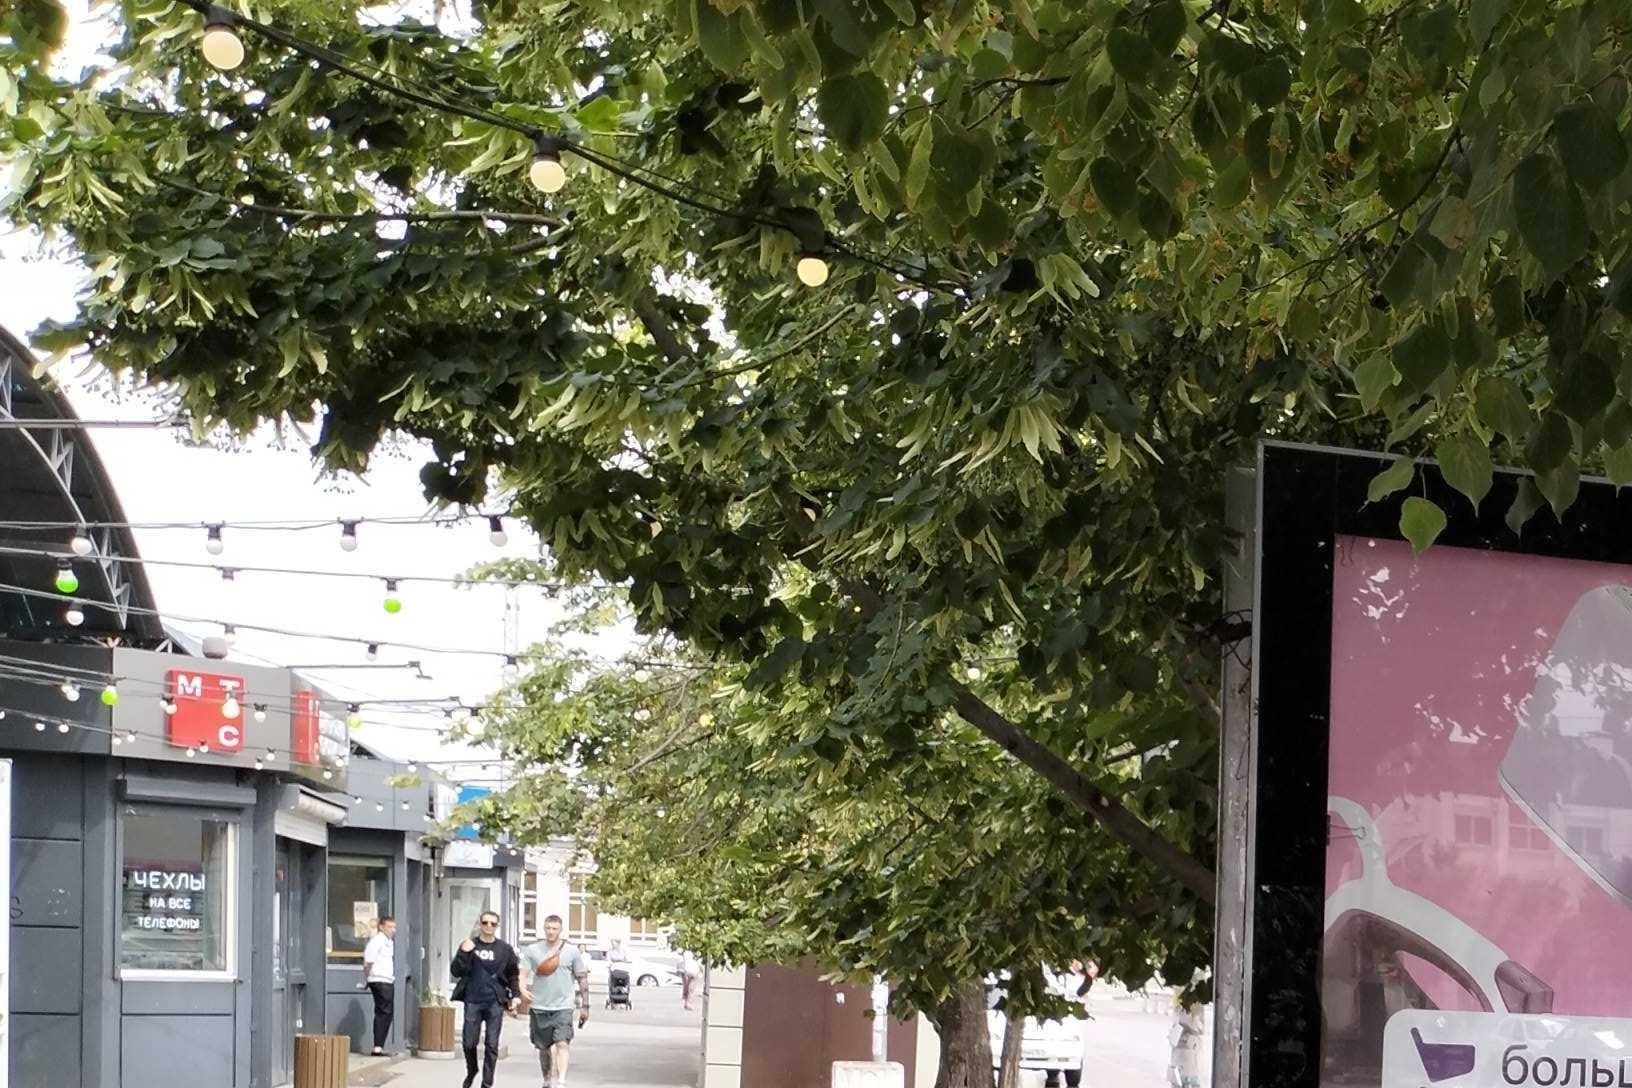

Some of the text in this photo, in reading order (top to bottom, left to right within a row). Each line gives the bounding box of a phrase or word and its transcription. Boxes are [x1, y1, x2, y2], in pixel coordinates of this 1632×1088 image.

[134, 871, 206, 890] ЧЕХЛЫ
[150, 898, 192, 909] НА ВСЕ
[137, 916, 200, 929] ТЕЛЕФОНЫ
